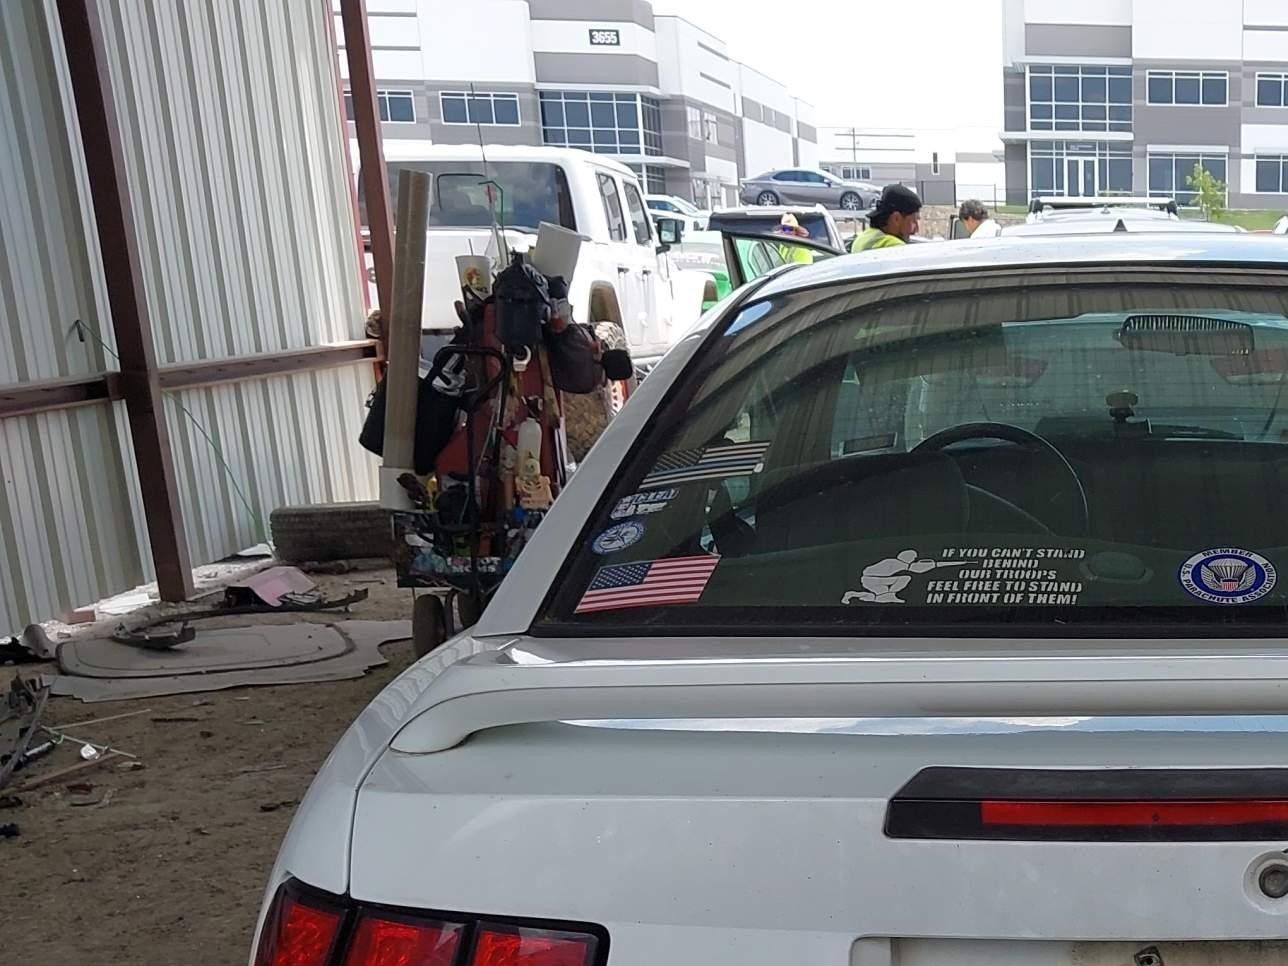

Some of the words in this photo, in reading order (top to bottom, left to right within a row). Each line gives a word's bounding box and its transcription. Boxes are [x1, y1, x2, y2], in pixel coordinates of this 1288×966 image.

[592, 30, 618, 44] 3655
[942, 548, 956, 558] IF
[959, 548, 988, 558] YOU
[991, 548, 1033, 558] CAN'T
[1202, 549, 1253, 557] MEMBER
[982, 559, 1039, 568] BEHIND
[959, 569, 991, 579] OUR
[995, 569, 1057, 580] TROOPS
[927, 580, 959, 591] FEEL
[963, 581, 1000, 591] FREE
[1005, 581, 1026, 592] TO
[1028, 581, 1082, 592] STAND
[1184, 580, 1237, 602] PARACHUTE
[1243, 562, 1275, 602] ASSOCIATION
[926, 593, 944, 603] IN
[946, 593, 1000, 603] FRONT
[1003, 593, 1025, 603] OF
[1028, 594, 1077, 605] THEM!
